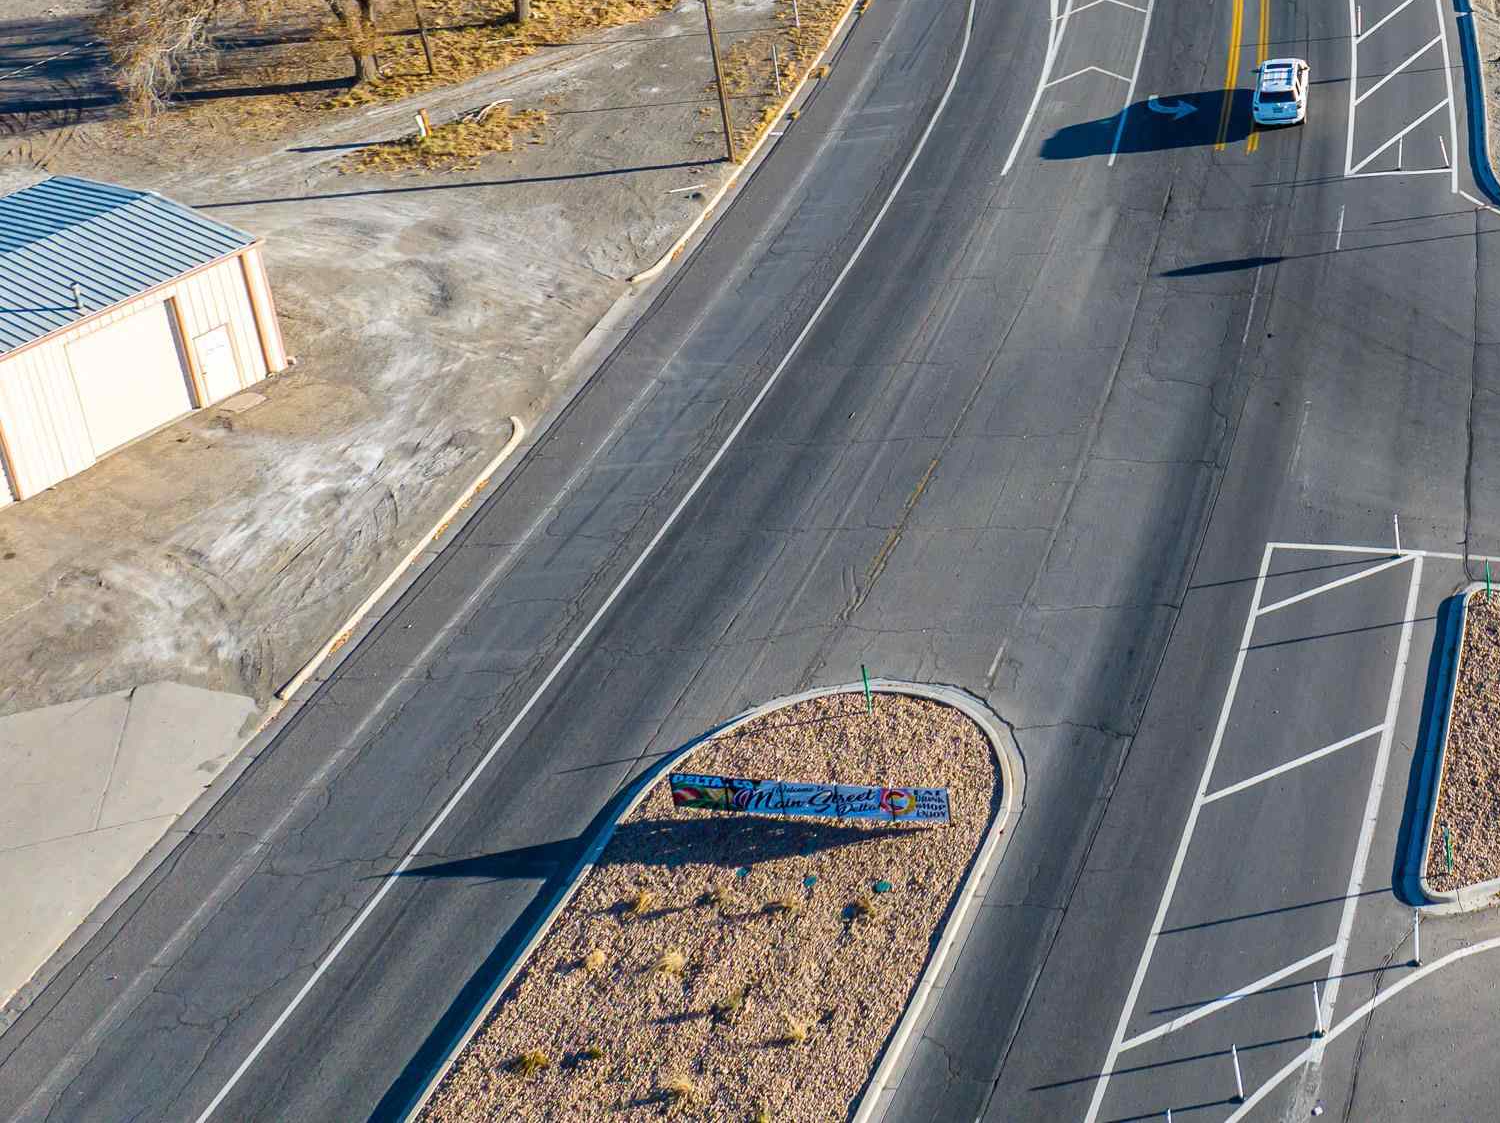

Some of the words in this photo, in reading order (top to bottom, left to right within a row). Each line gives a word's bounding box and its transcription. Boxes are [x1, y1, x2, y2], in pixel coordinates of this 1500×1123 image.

[672, 774, 722, 788] DELTA
[735, 787, 802, 810] Main
[808, 787, 876, 813] Street
[916, 803, 946, 811] SHOP
[917, 810, 946, 818] ENJOY
